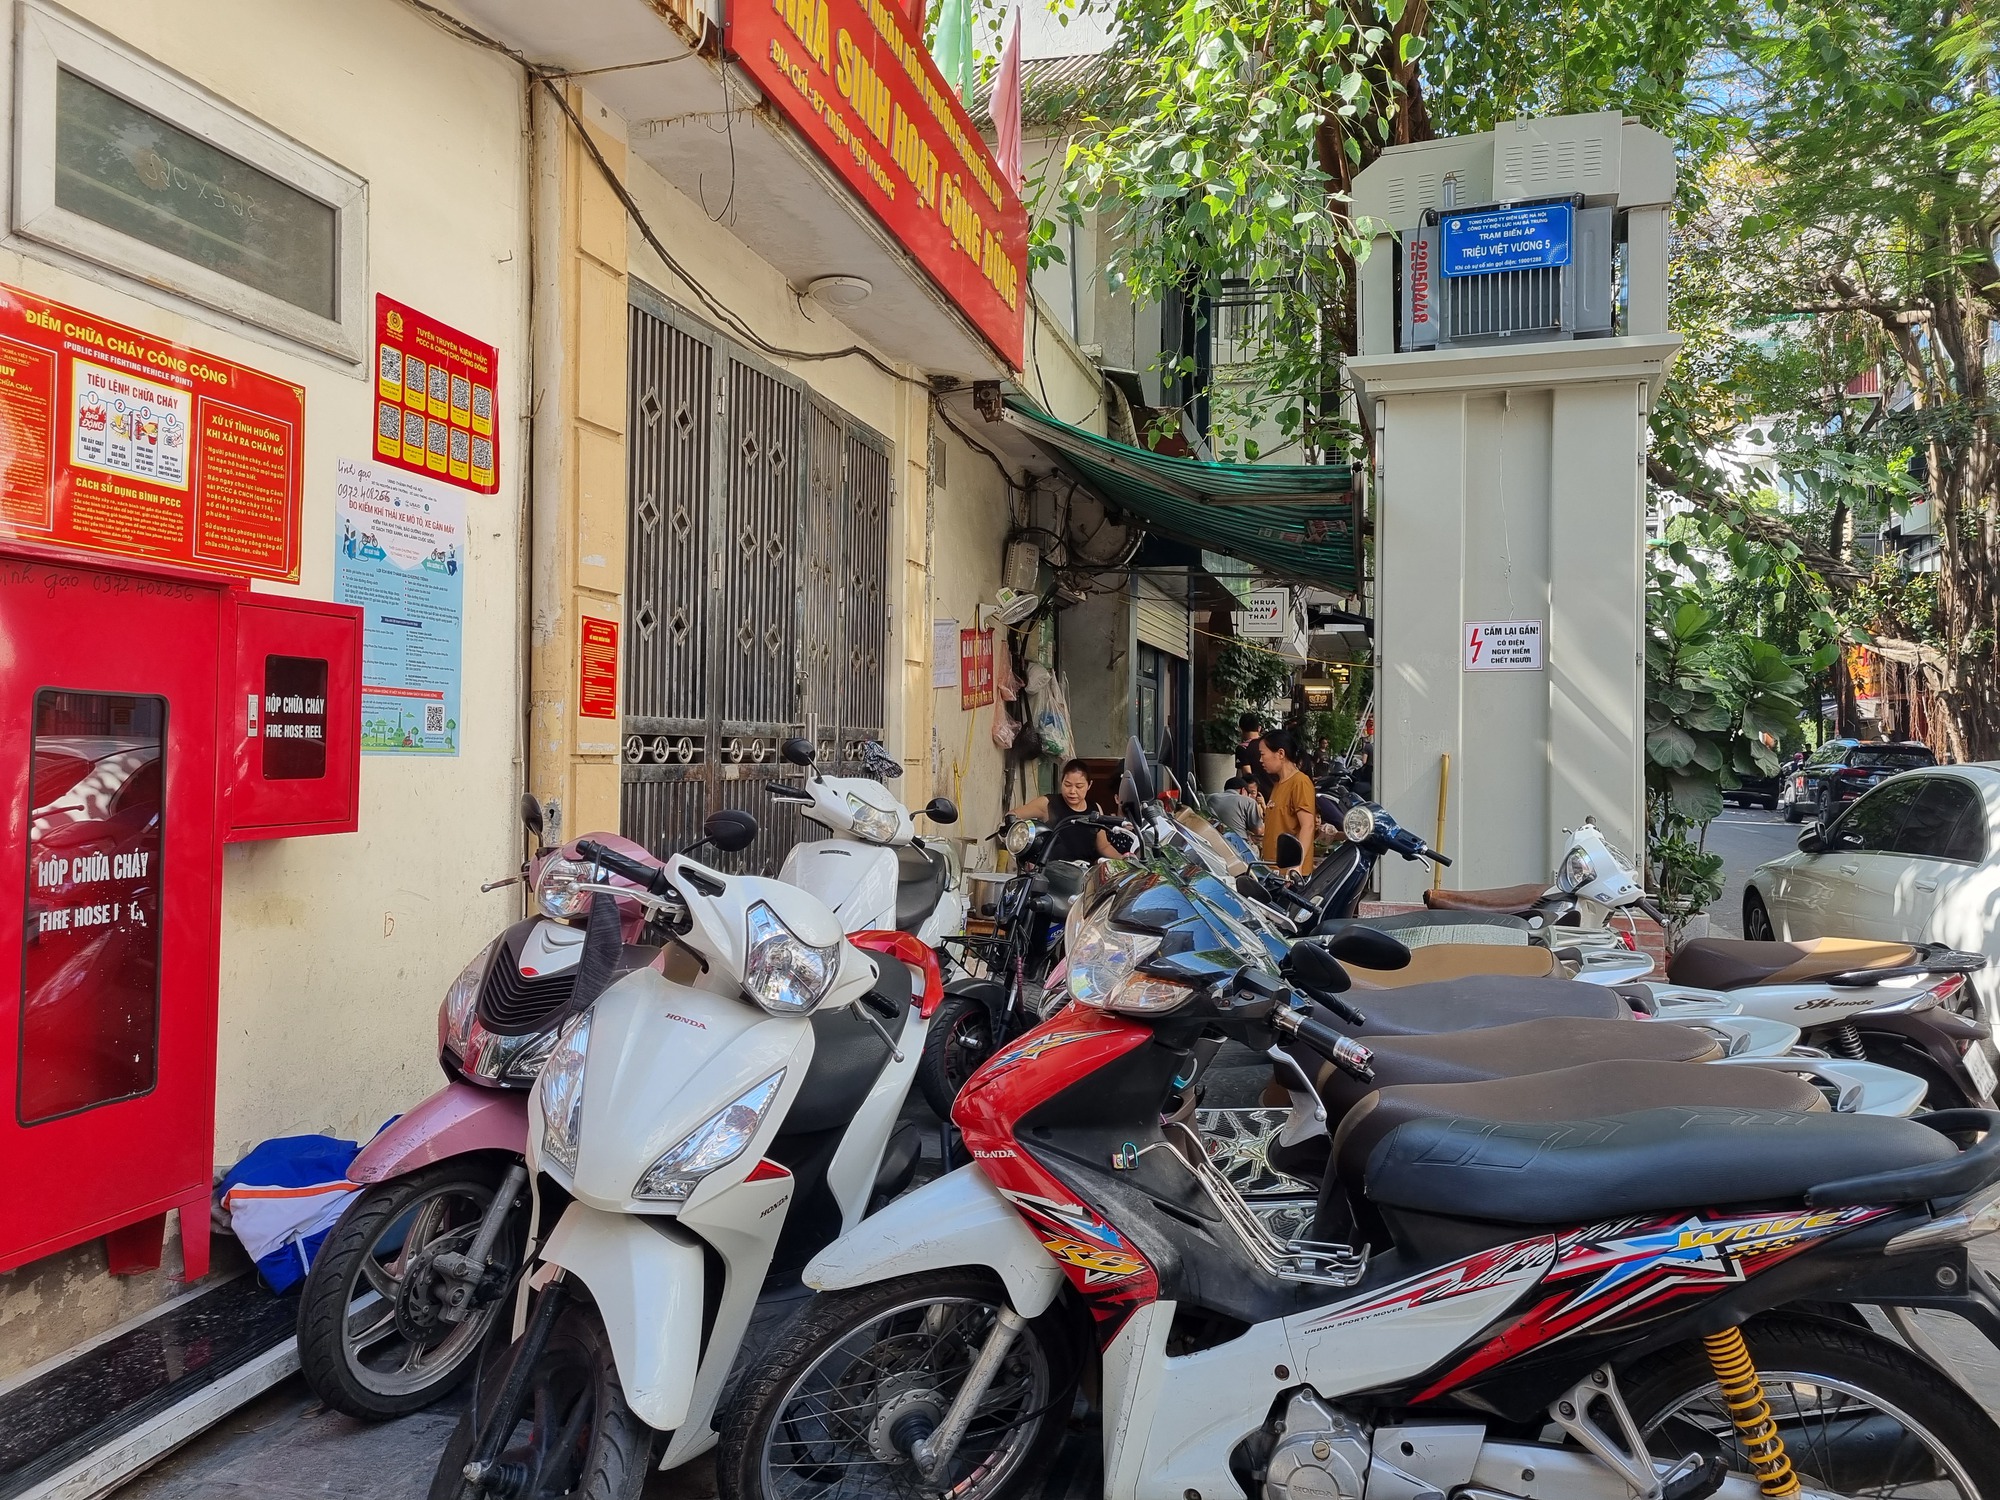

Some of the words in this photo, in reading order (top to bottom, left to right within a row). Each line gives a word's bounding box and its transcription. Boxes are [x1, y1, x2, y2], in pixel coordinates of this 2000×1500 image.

[769, 38, 790, 77] ĐỊA
[824, 103, 849, 145] TRIỆU
[849, 132, 867, 167] VIỆT
[834, 28, 890, 149] SINH
[890, 101, 939, 210] HOẠT
[939, 172, 982, 267] CỘNG
[991, 180, 1003, 213] DU
[1479, 231, 1502, 241] TRẠM
[1503, 227, 1523, 238] BIẾN
[1523, 226, 1536, 236] ÁP
[1462, 245, 1487, 259] TRIỆU
[1489, 242, 1509, 257] VIỆT
[1510, 240, 1543, 253] VƯƠNG
[1545, 239, 1551, 249] 5
[25, 308, 62, 333] ĐIỂM
[64, 323, 104, 347] CHỮA
[107, 337, 145, 359] CHÁY
[147, 350, 187, 372] CÔNG
[189, 364, 228, 385] CỘNG
[415, 336, 430, 349] PCCC
[0, 365, 16, 377] UY
[63, 341, 93, 356] (PUBLIC
[93, 350, 109, 362] FIRE
[110, 356, 141, 372] FIGHTING
[142, 366, 170, 380] VEHICLE
[170, 374, 193, 388] POINT)
[87, 373, 106, 389] TIÊU
[108, 379, 130, 396] LỆNH
[132, 387, 154, 404] CHỮA
[156, 394, 178, 409] CHÁY
[117, 402, 123, 410] 2
[143, 409, 148, 418] 3
[81, 419, 104, 431] ĐỘNG
[168, 416, 174, 424] 4
[212, 414, 224, 426] XỬ
[224, 418, 234, 429] LÝ
[234, 421, 252, 434] TÌNH
[253, 427, 280, 442] HUỐNG
[206, 427, 221, 439] KHI
[222, 432, 239, 444] XẢY
[240, 437, 250, 447] RA
[251, 440, 272, 453] CHÁY
[76, 477, 99, 491] CÁCH
[101, 482, 114, 493] SỬ
[114, 486, 138, 499] DỤNG
[138, 490, 159, 504] BÌNH
[160, 495, 181, 508] PCCC
[216, 485, 233, 494] PCCC
[349, 499, 357, 510] ĐO
[374, 506, 384, 517] KHÍ
[385, 508, 397, 519] THẢI
[399, 512, 406, 522] XE
[406, 513, 416, 525] MÔ
[416, 516, 424, 528] TÔ,
[424, 518, 432, 528] XE
[444, 523, 455, 535] MÁY
[0, 564, 35, 587] inh
[44, 573, 79, 599] gạo
[93, 575, 130, 594] 0972
[135, 581, 195, 601] 408256
[1484, 624, 1502, 636] CẤM
[1504, 627, 1517, 637] LẠI
[1496, 639, 1507, 647] CÓ
[1508, 638, 1525, 647] ĐIỆN
[1490, 656, 1508, 664] CHẾT
[265, 692, 282, 717] HỘP
[283, 694, 304, 714] CHỮA
[305, 695, 325, 715] CHÁY
[266, 724, 283, 738] FIRE
[284, 724, 304, 738] HOSE
[304, 725, 323, 738] REEL
[38, 854, 69, 893] HỘP
[72, 850, 110, 884] CHỮA
[113, 847, 149, 880] CHÁY
[39, 908, 71, 932] FIRE
[74, 904, 111, 928] HOSE
[664, 1012, 707, 1031] HONDA
[973, 1149, 1017, 1159] HONDA
[759, 1194, 790, 1219] HONDA
[1304, 1324, 1335, 1335] URBAN
[1337, 1314, 1372, 1327] SPORTY
[1373, 1306, 1404, 1318] MOVER
[1293, 1485, 1333, 1497] HONDA
